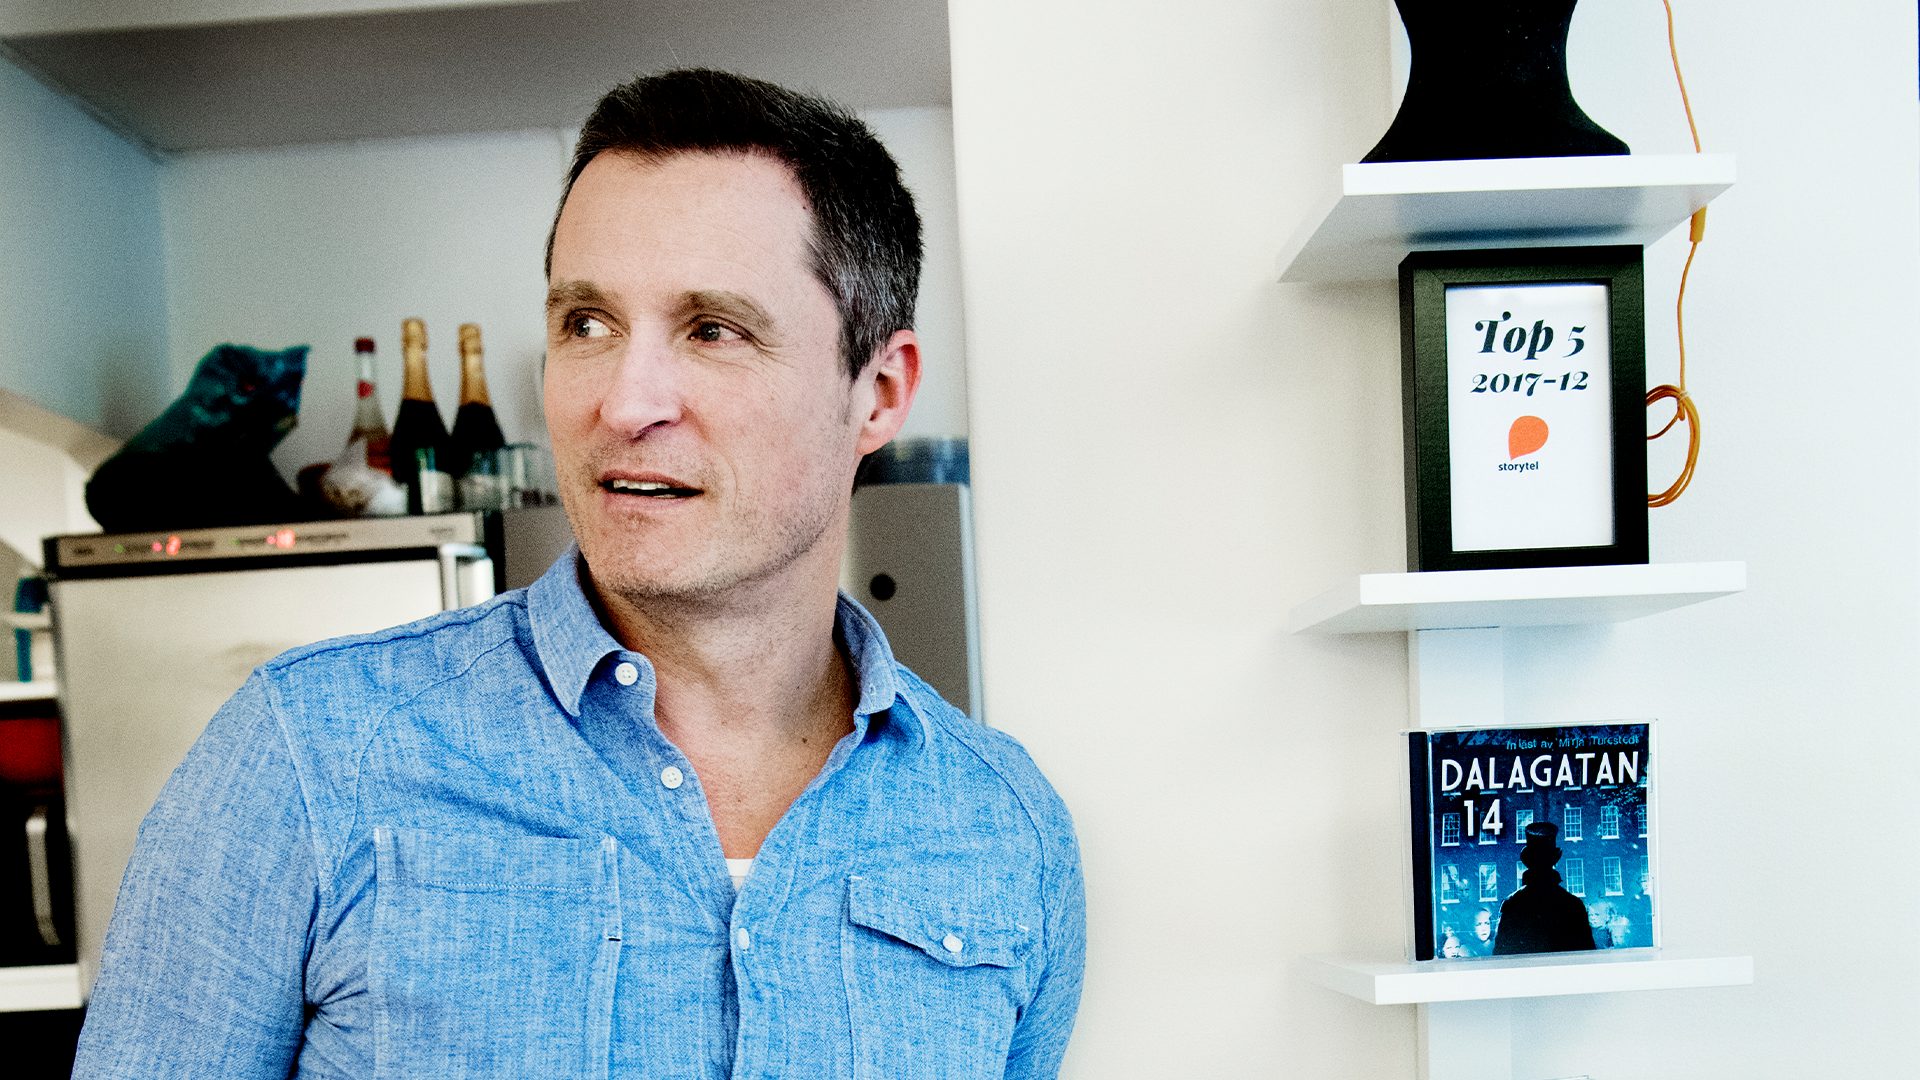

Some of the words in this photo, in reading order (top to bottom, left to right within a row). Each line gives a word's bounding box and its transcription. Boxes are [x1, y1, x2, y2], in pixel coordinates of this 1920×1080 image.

[1475, 311, 1554, 361] Top
[1562, 325, 1586, 358] 5
[1470, 371, 1589, 397] 2017-12
[1498, 461, 1539, 473] storytel
[1541, 740, 1554, 749] av
[1441, 751, 1639, 792] DALAGATAN
[1464, 799, 1503, 836] 14
